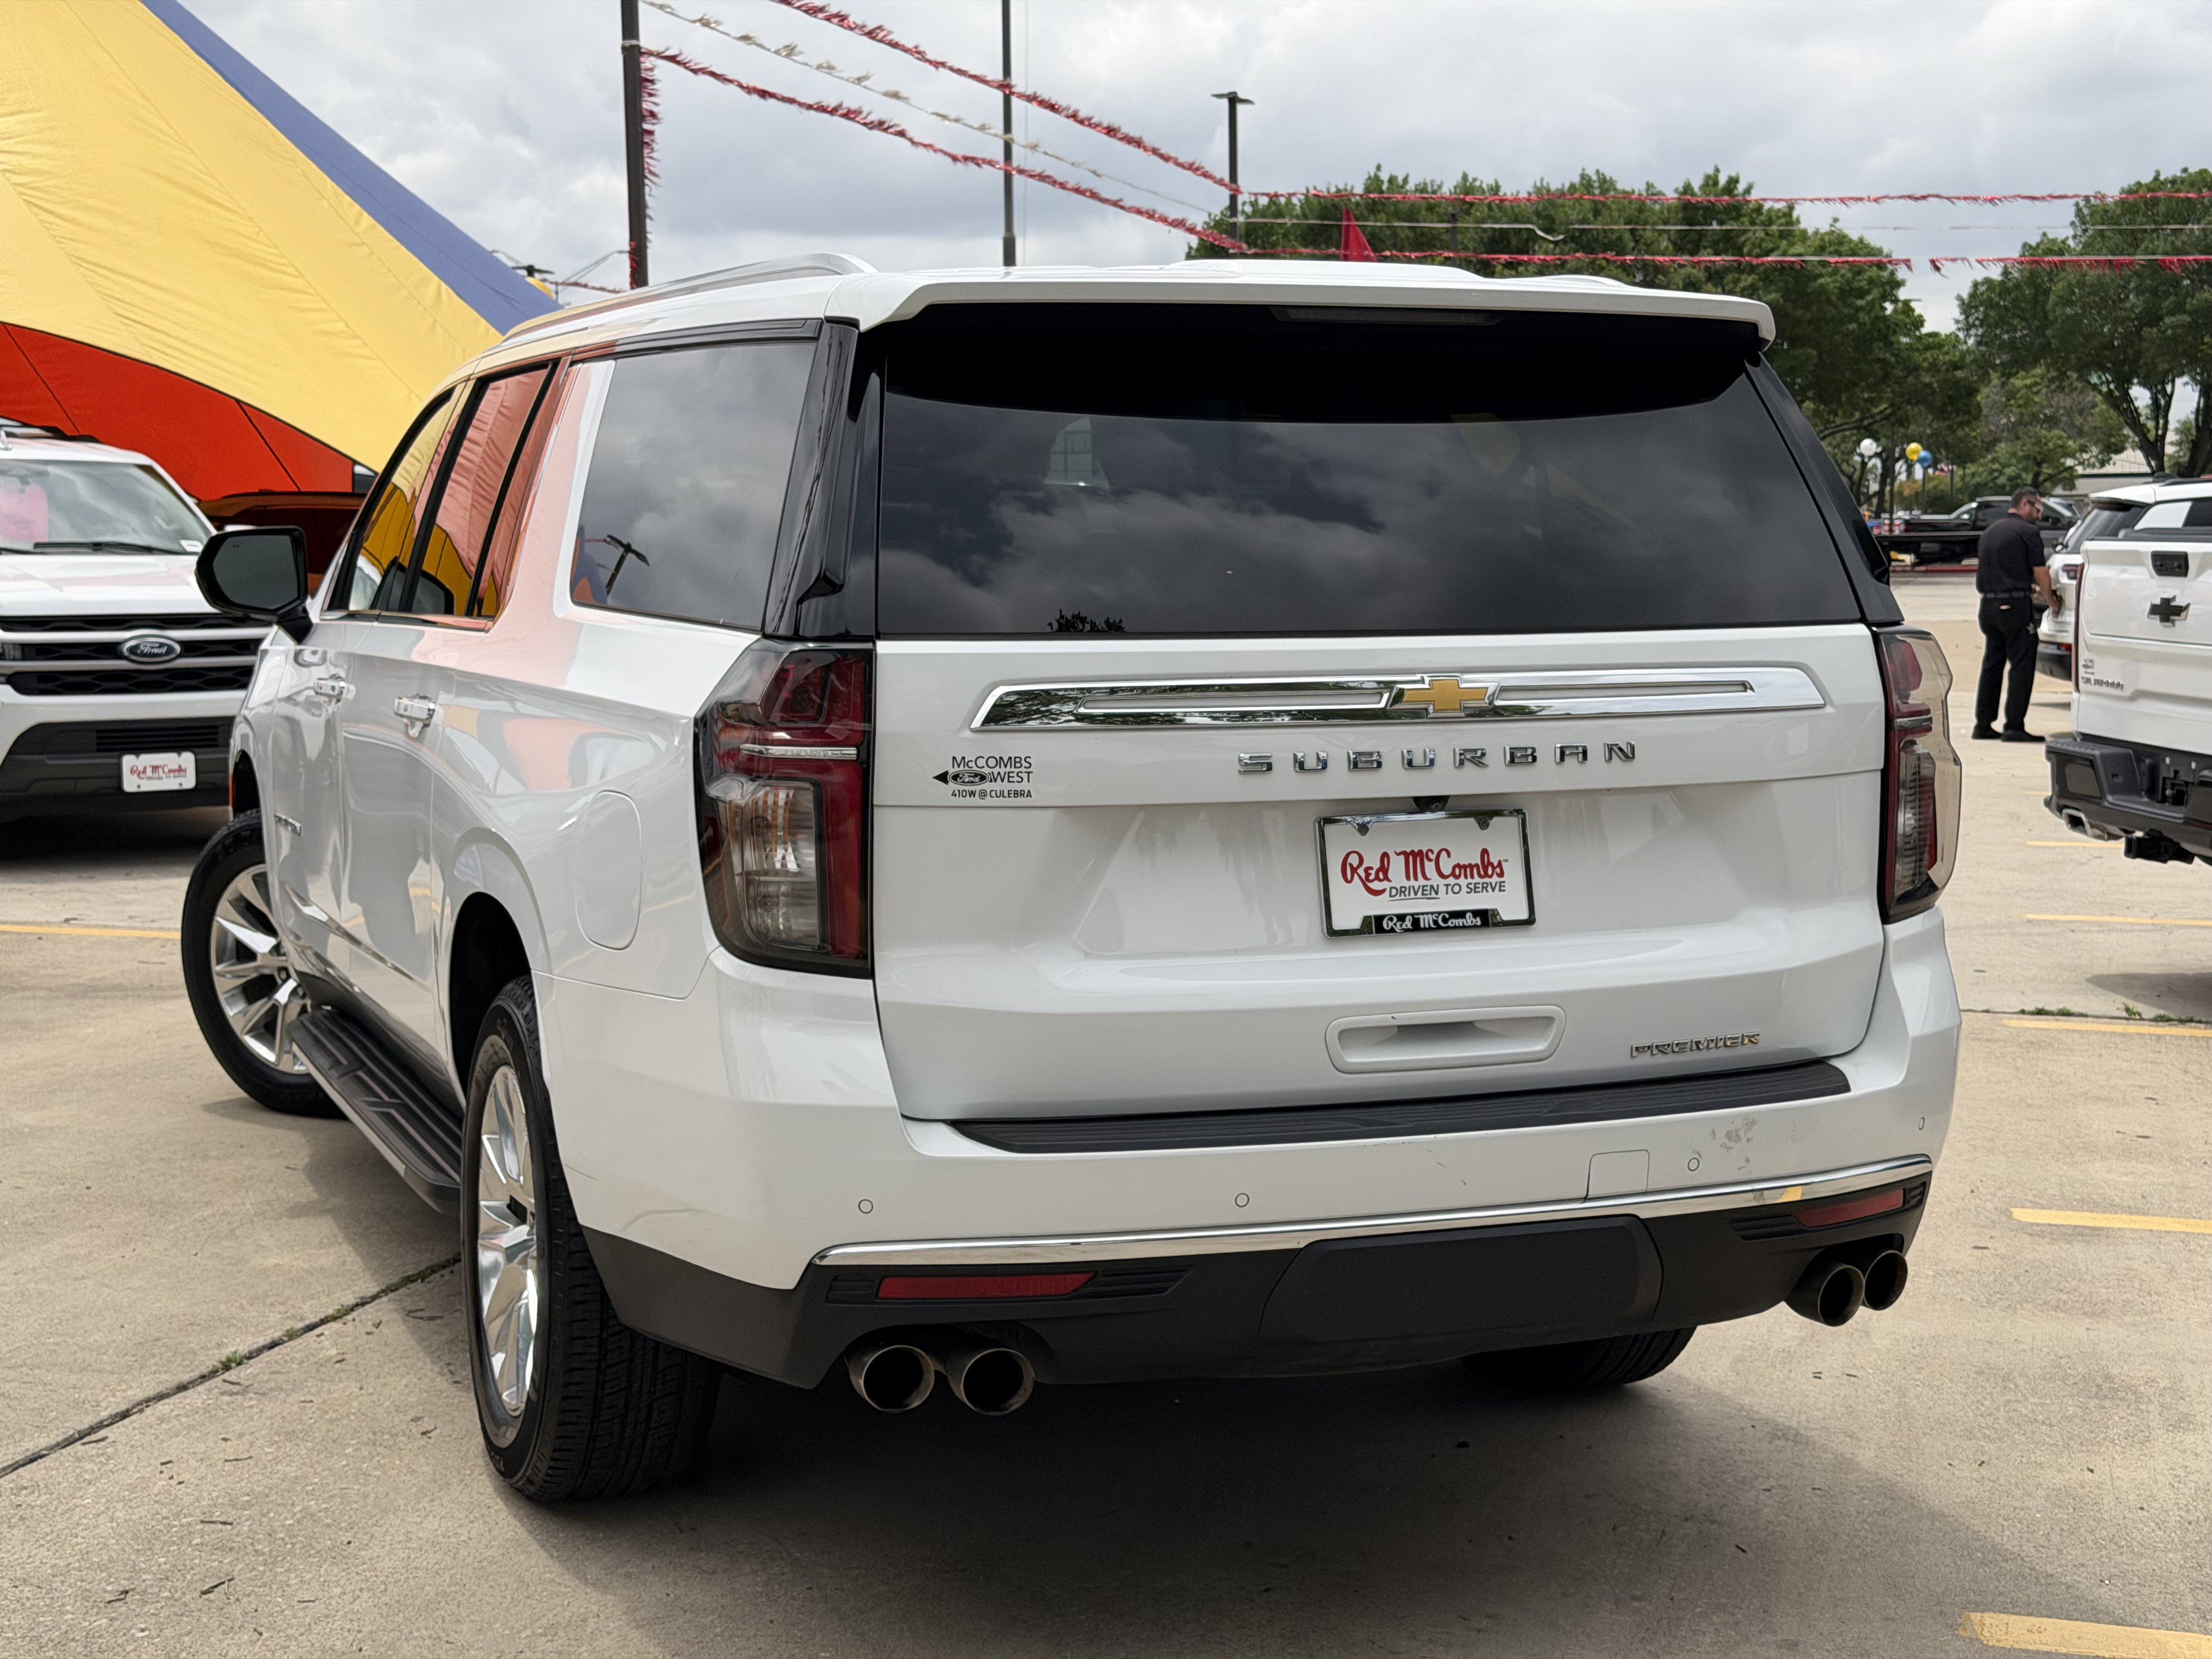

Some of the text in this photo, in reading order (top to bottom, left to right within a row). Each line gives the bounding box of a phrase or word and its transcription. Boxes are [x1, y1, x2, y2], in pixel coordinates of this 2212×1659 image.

[952, 755, 1032, 769] McCOMBS
[1237, 741, 1636, 774] SUBURBAN
[957, 771, 1034, 783] Ford WEST
[951, 789, 977, 798] 410W
[989, 789, 1032, 798] CULEBRA
[1340, 848, 1505, 896] Red McCombs
[1389, 881, 1506, 898] DRIVEN TO SERVE
[1382, 912, 1482, 932] Red McCombs
[1630, 1031, 1760, 1058] PREMIER
